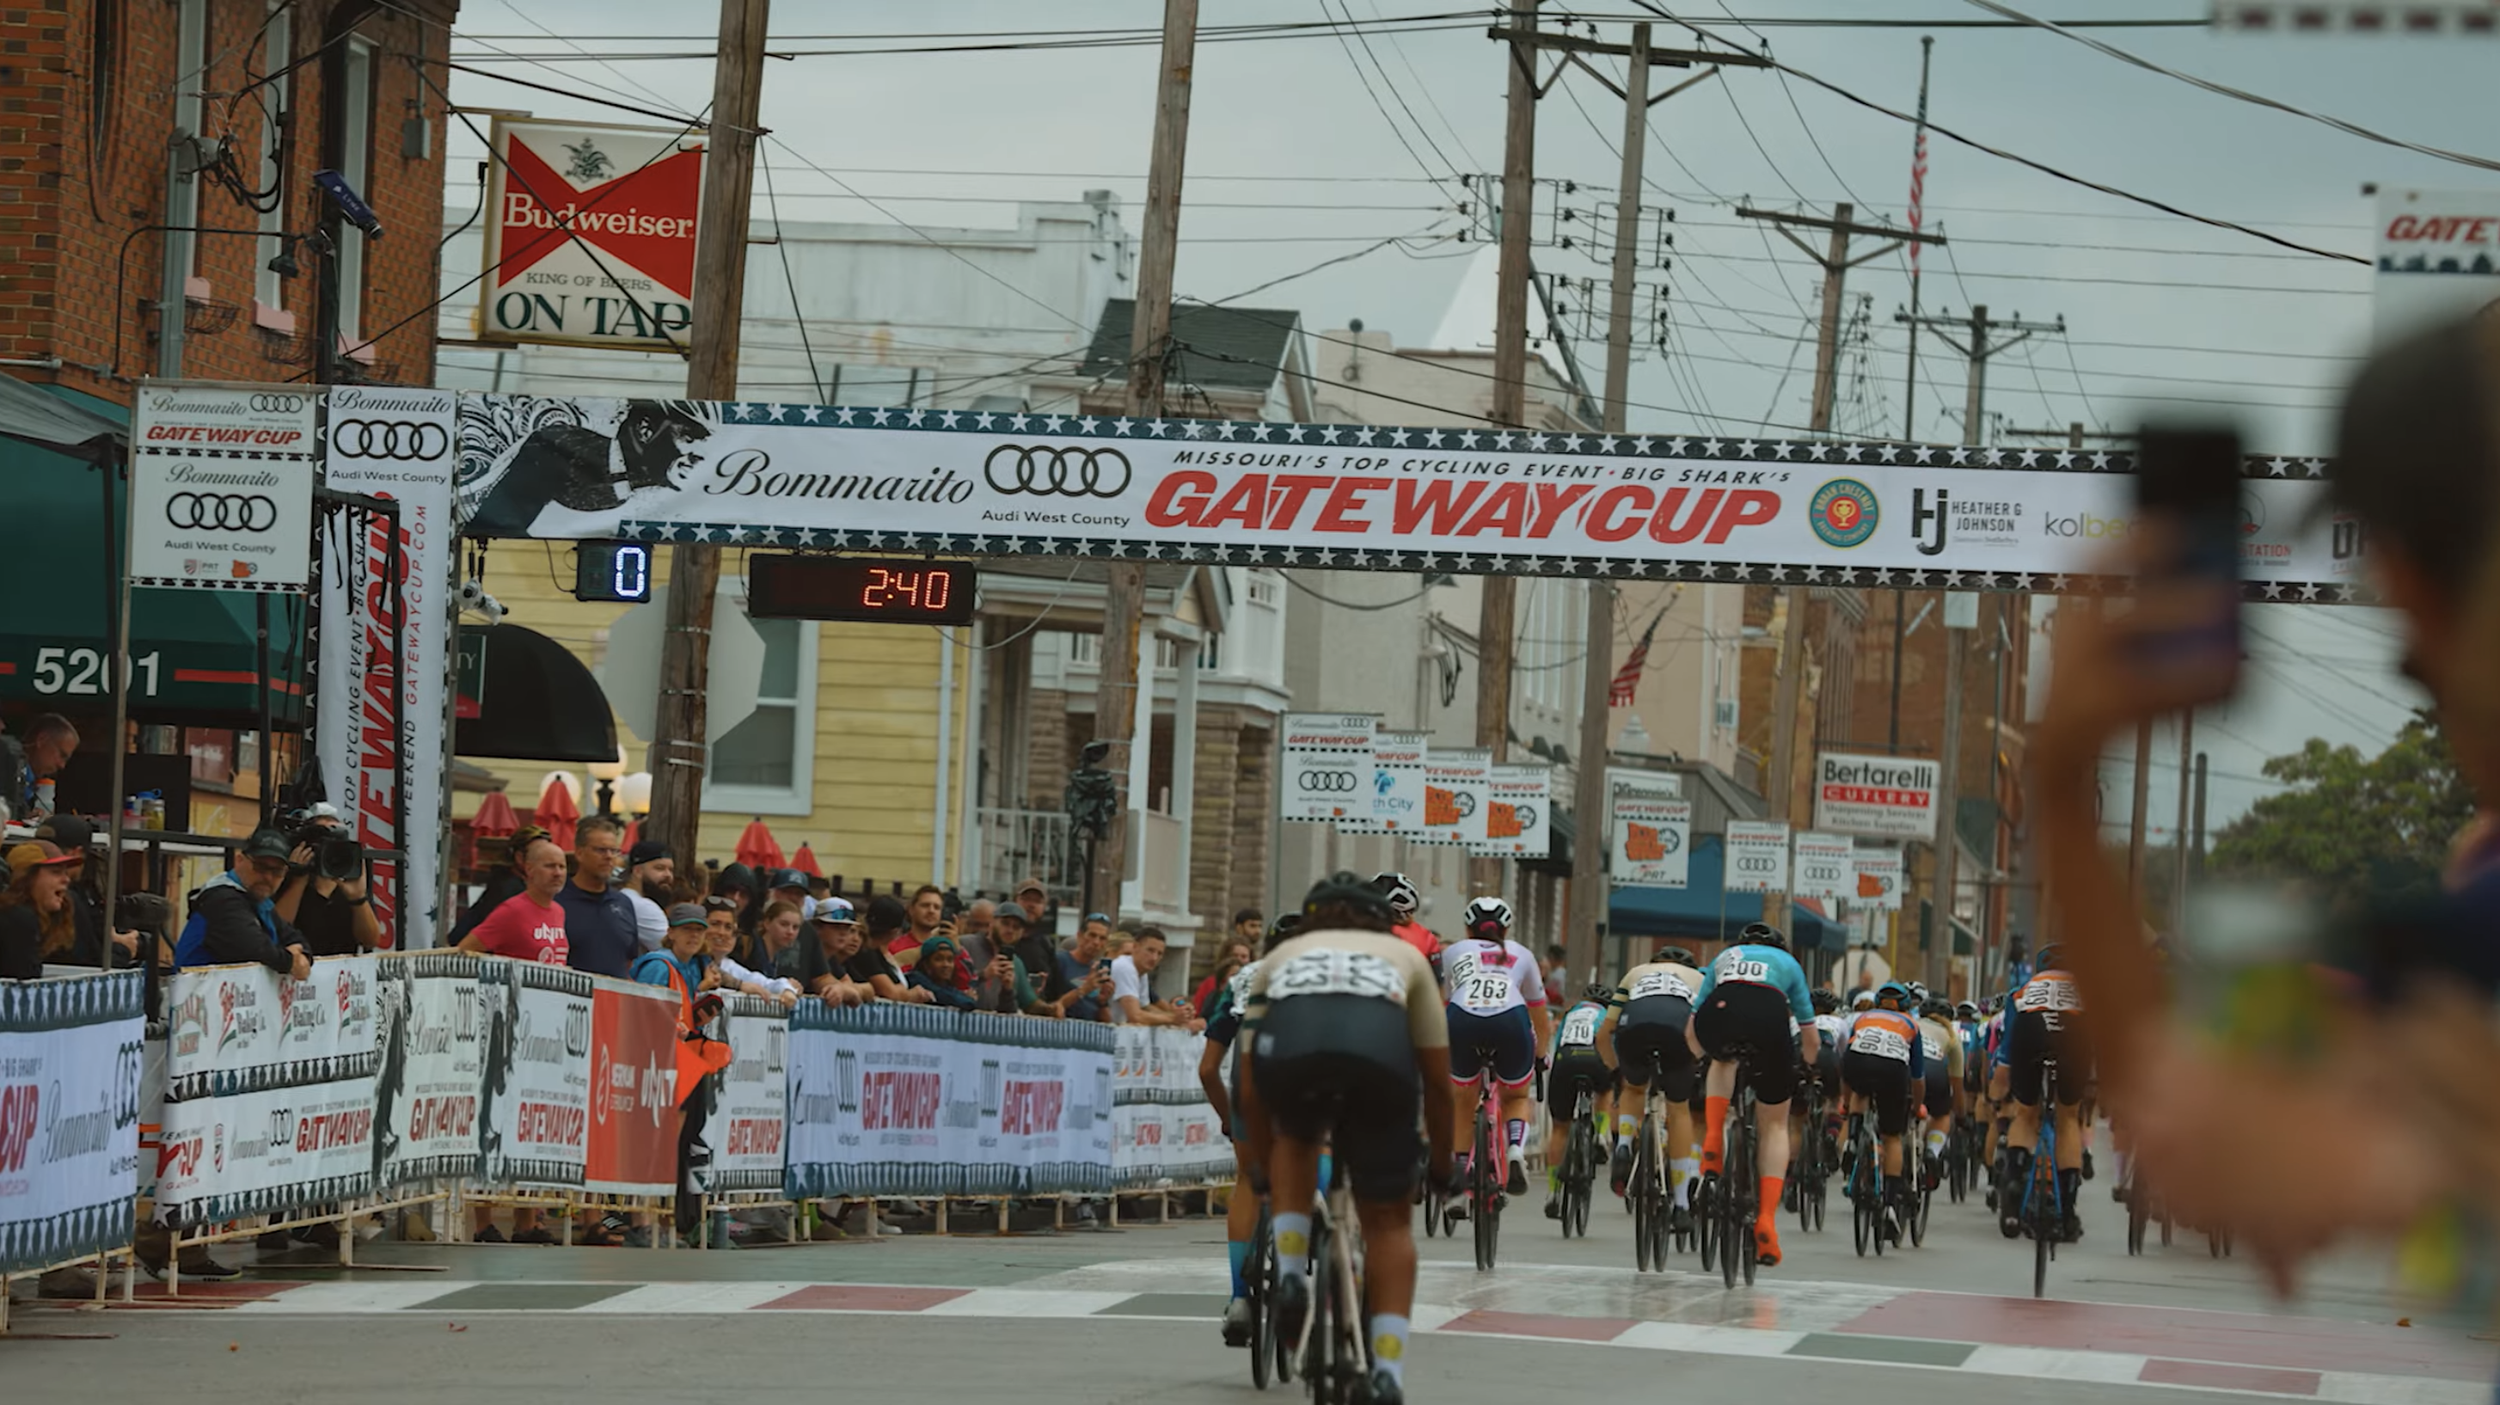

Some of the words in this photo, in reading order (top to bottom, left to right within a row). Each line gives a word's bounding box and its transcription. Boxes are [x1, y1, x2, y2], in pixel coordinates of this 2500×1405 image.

[503, 192, 694, 239] Budweiser
[526, 272, 568, 286] KING
[574, 276, 595, 287] OF
[600, 277, 652, 291] BEERS
[496, 291, 571, 333] ON
[583, 296, 691, 340] TAP
[148, 394, 247, 415] Bommarito
[333, 388, 451, 413] Bommarito
[165, 463, 279, 487] Bommarito
[331, 470, 361, 480] Audi
[365, 471, 398, 481] West
[402, 473, 447, 485] County
[704, 449, 974, 504] Bommarito
[1173, 450, 1328, 469] MISSOURI'S
[1341, 456, 1389, 471] TOP
[1402, 458, 1511, 476] CYCLING
[1523, 463, 1603, 479] EVENT
[1621, 466, 1665, 482] BIG
[1679, 469, 1791, 485] SHARK'S
[982, 509, 1019, 522] Audi
[1024, 511, 1067, 523] West
[1072, 512, 1130, 528] County
[1952, 501, 2010, 516] HEATHER
[2014, 503, 2022, 516] G
[1956, 518, 2015, 532] JOHNSON
[165, 540, 193, 550] Audi
[196, 541, 228, 551] West
[232, 542, 276, 555] County
[616, 546, 646, 597] 0
[353, 575, 366, 608] BIG
[862, 568, 950, 610] 2:40
[405, 505, 427, 705] GATEWAYCUP.COM
[350, 619, 363, 680] EVENT
[346, 687, 361, 767] CYCLING
[1824, 760, 1932, 789] Bertarelli
[345, 775, 357, 812] TOP
[1388, 798, 1413, 811] City
[1826, 788, 1927, 807] CUTLERY
[1469, 979, 1508, 999] 263
